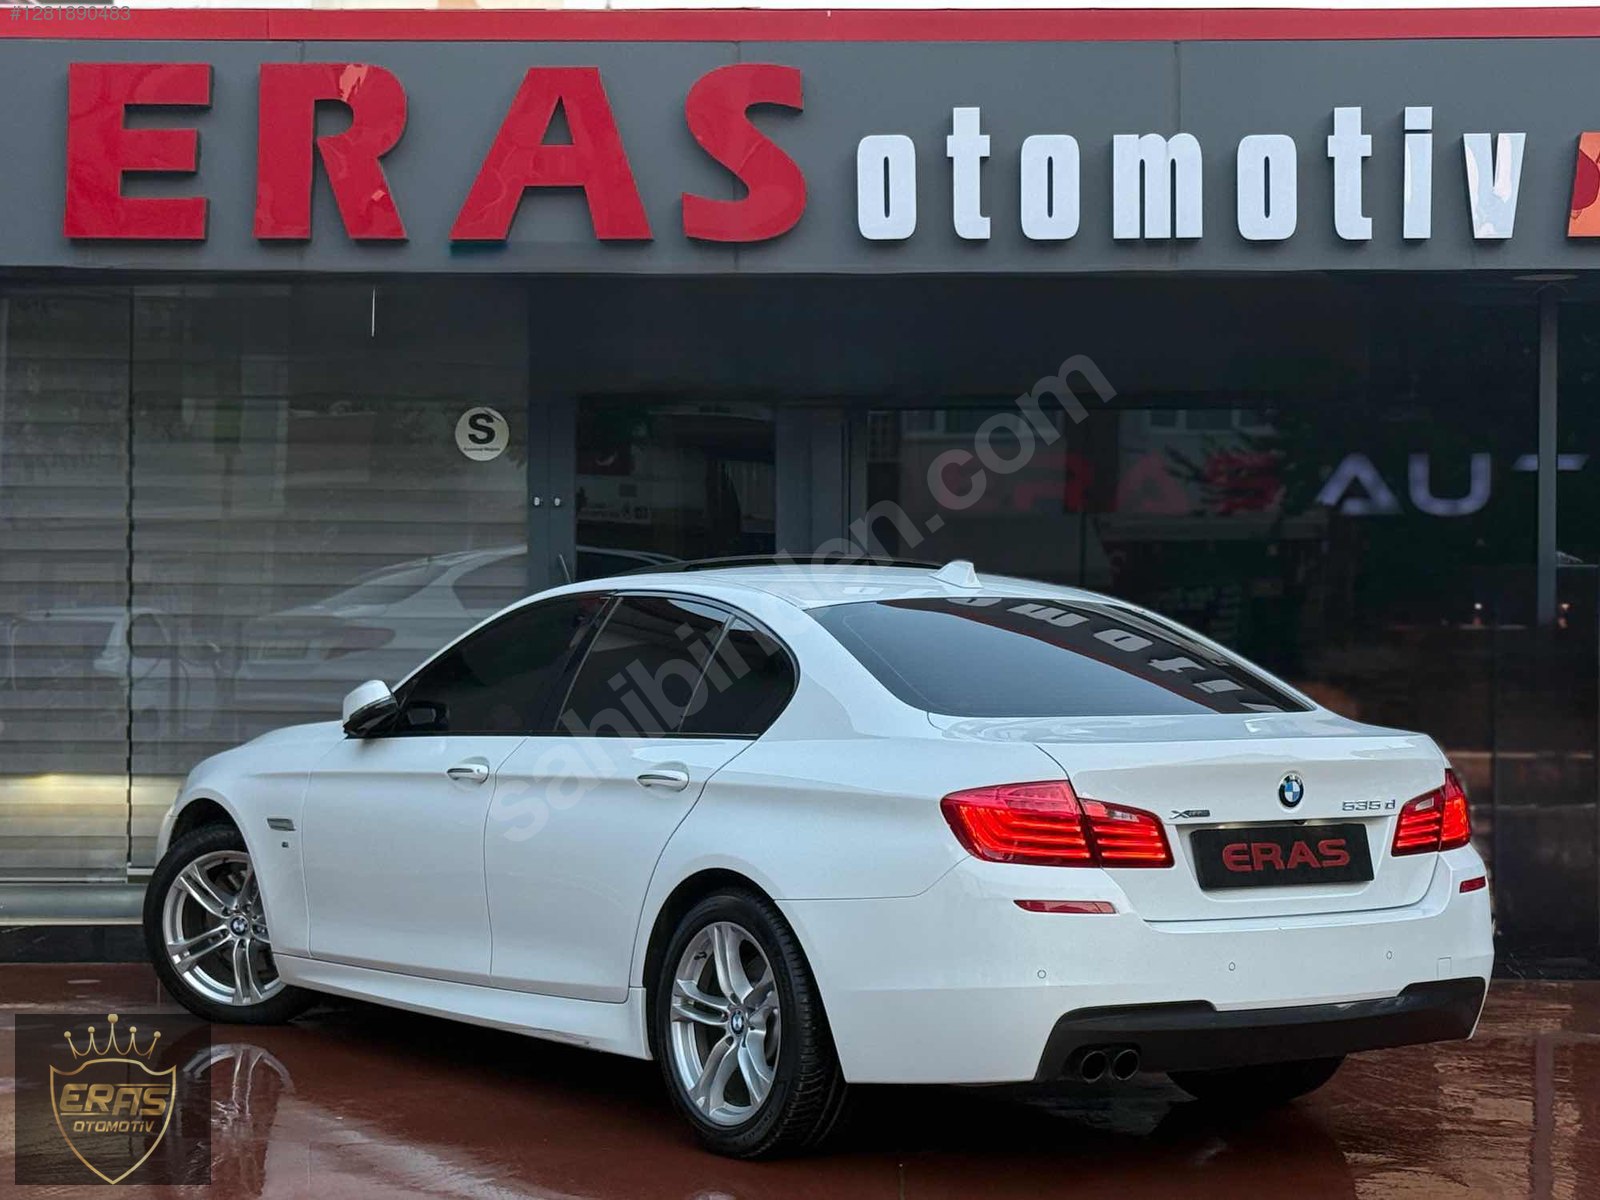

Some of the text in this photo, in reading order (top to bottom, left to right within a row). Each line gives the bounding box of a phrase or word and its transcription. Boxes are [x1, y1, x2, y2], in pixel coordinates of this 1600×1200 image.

[64, 62, 1526, 243] ERAS otomotiv
[468, 413, 496, 445] S
[938, 450, 1285, 516] RAS
[1221, 838, 1350, 873] ERAS
